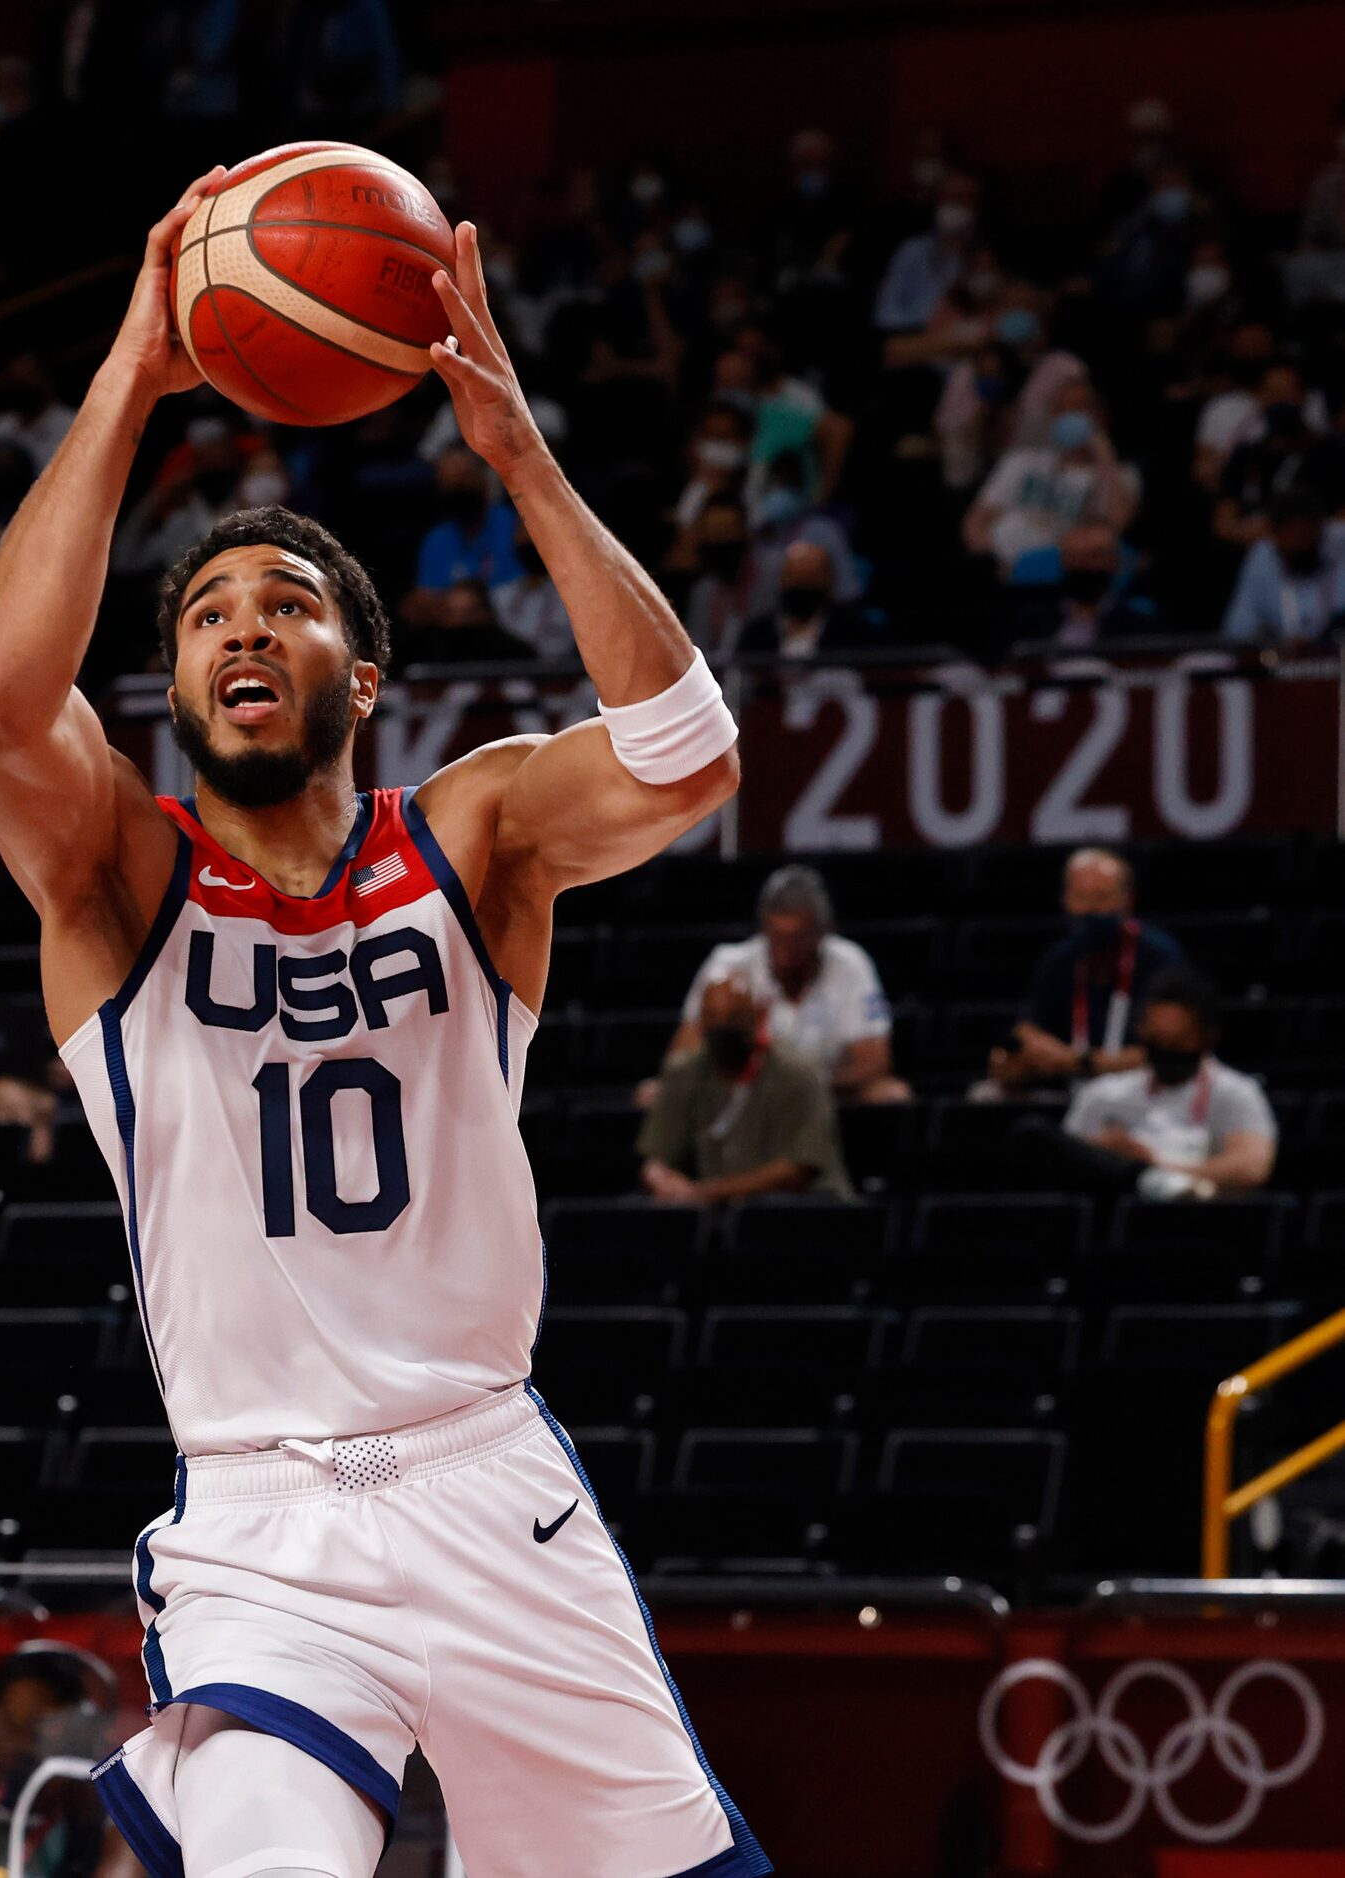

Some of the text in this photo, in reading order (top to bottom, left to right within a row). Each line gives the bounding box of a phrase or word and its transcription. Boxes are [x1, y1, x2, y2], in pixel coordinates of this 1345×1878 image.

[781, 652, 1255, 854] 2020
[185, 926, 449, 1042] USA
[251, 1057, 411, 1238] 10
